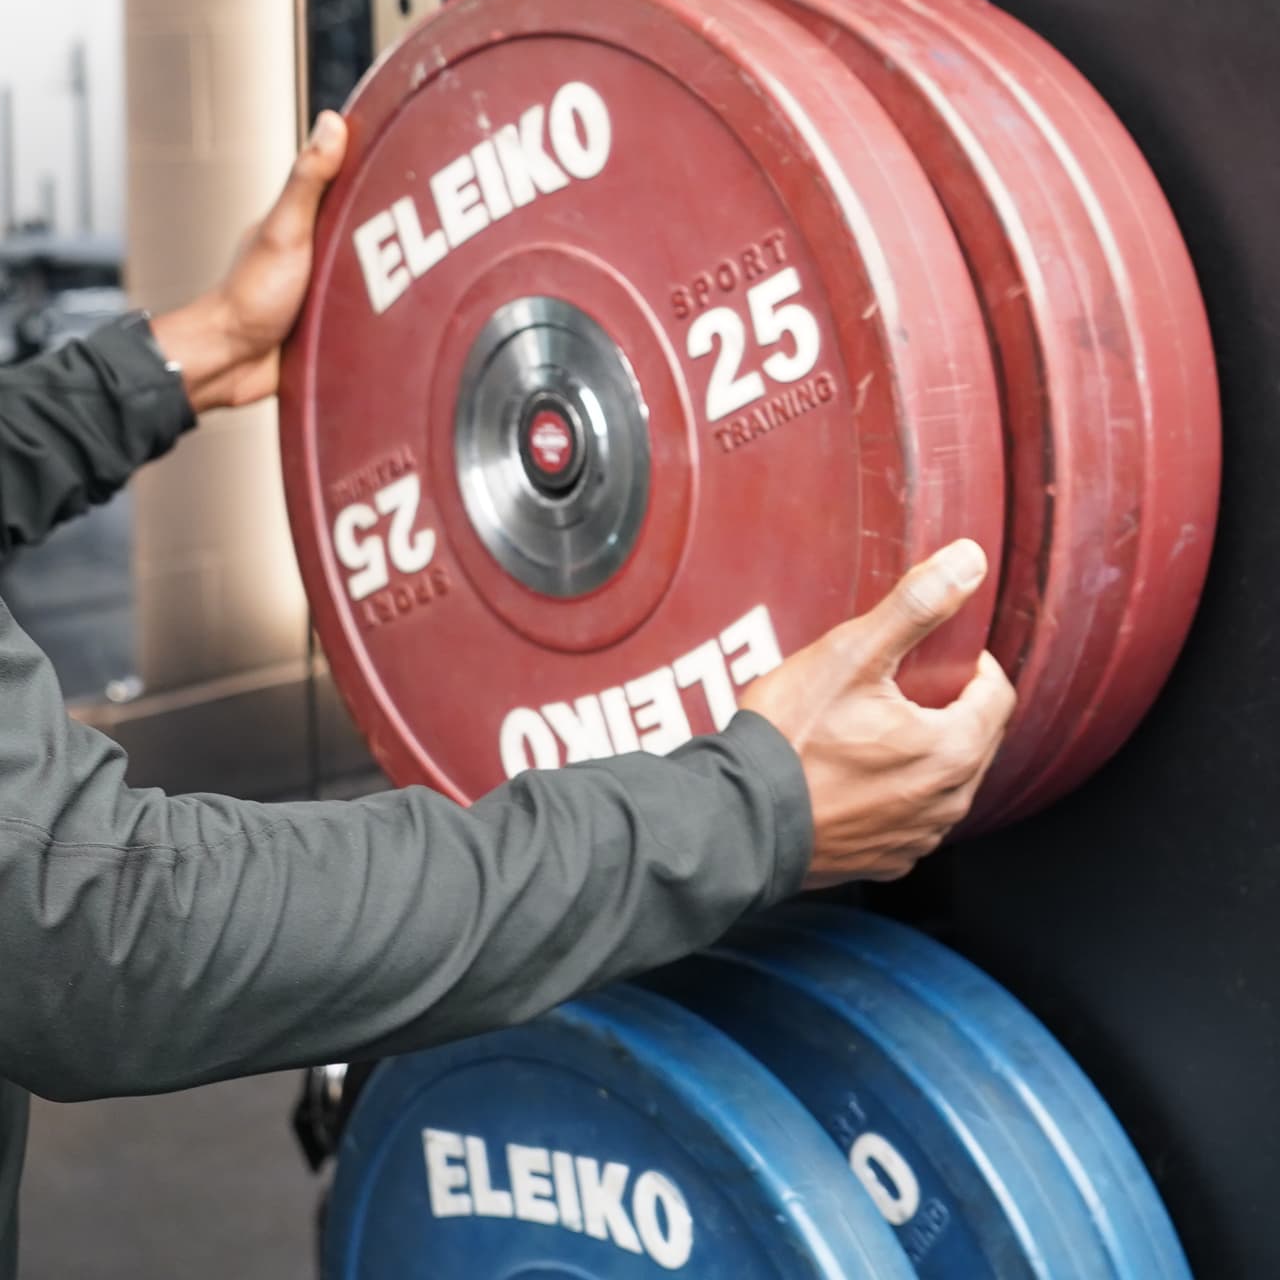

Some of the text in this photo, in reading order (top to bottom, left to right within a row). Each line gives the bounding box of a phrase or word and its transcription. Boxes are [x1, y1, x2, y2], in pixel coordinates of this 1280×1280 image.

[353, 80, 613, 313] ELEIKO
[670, 228, 788, 320] SPORT
[686, 266, 822, 423] 25
[712, 371, 838, 453] TRAINING
[334, 472, 437, 599] 25
[500, 604, 784, 780] ELEIKO
[422, 1128, 695, 1270] ELEIKO
[851, 1134, 919, 1225] 0
